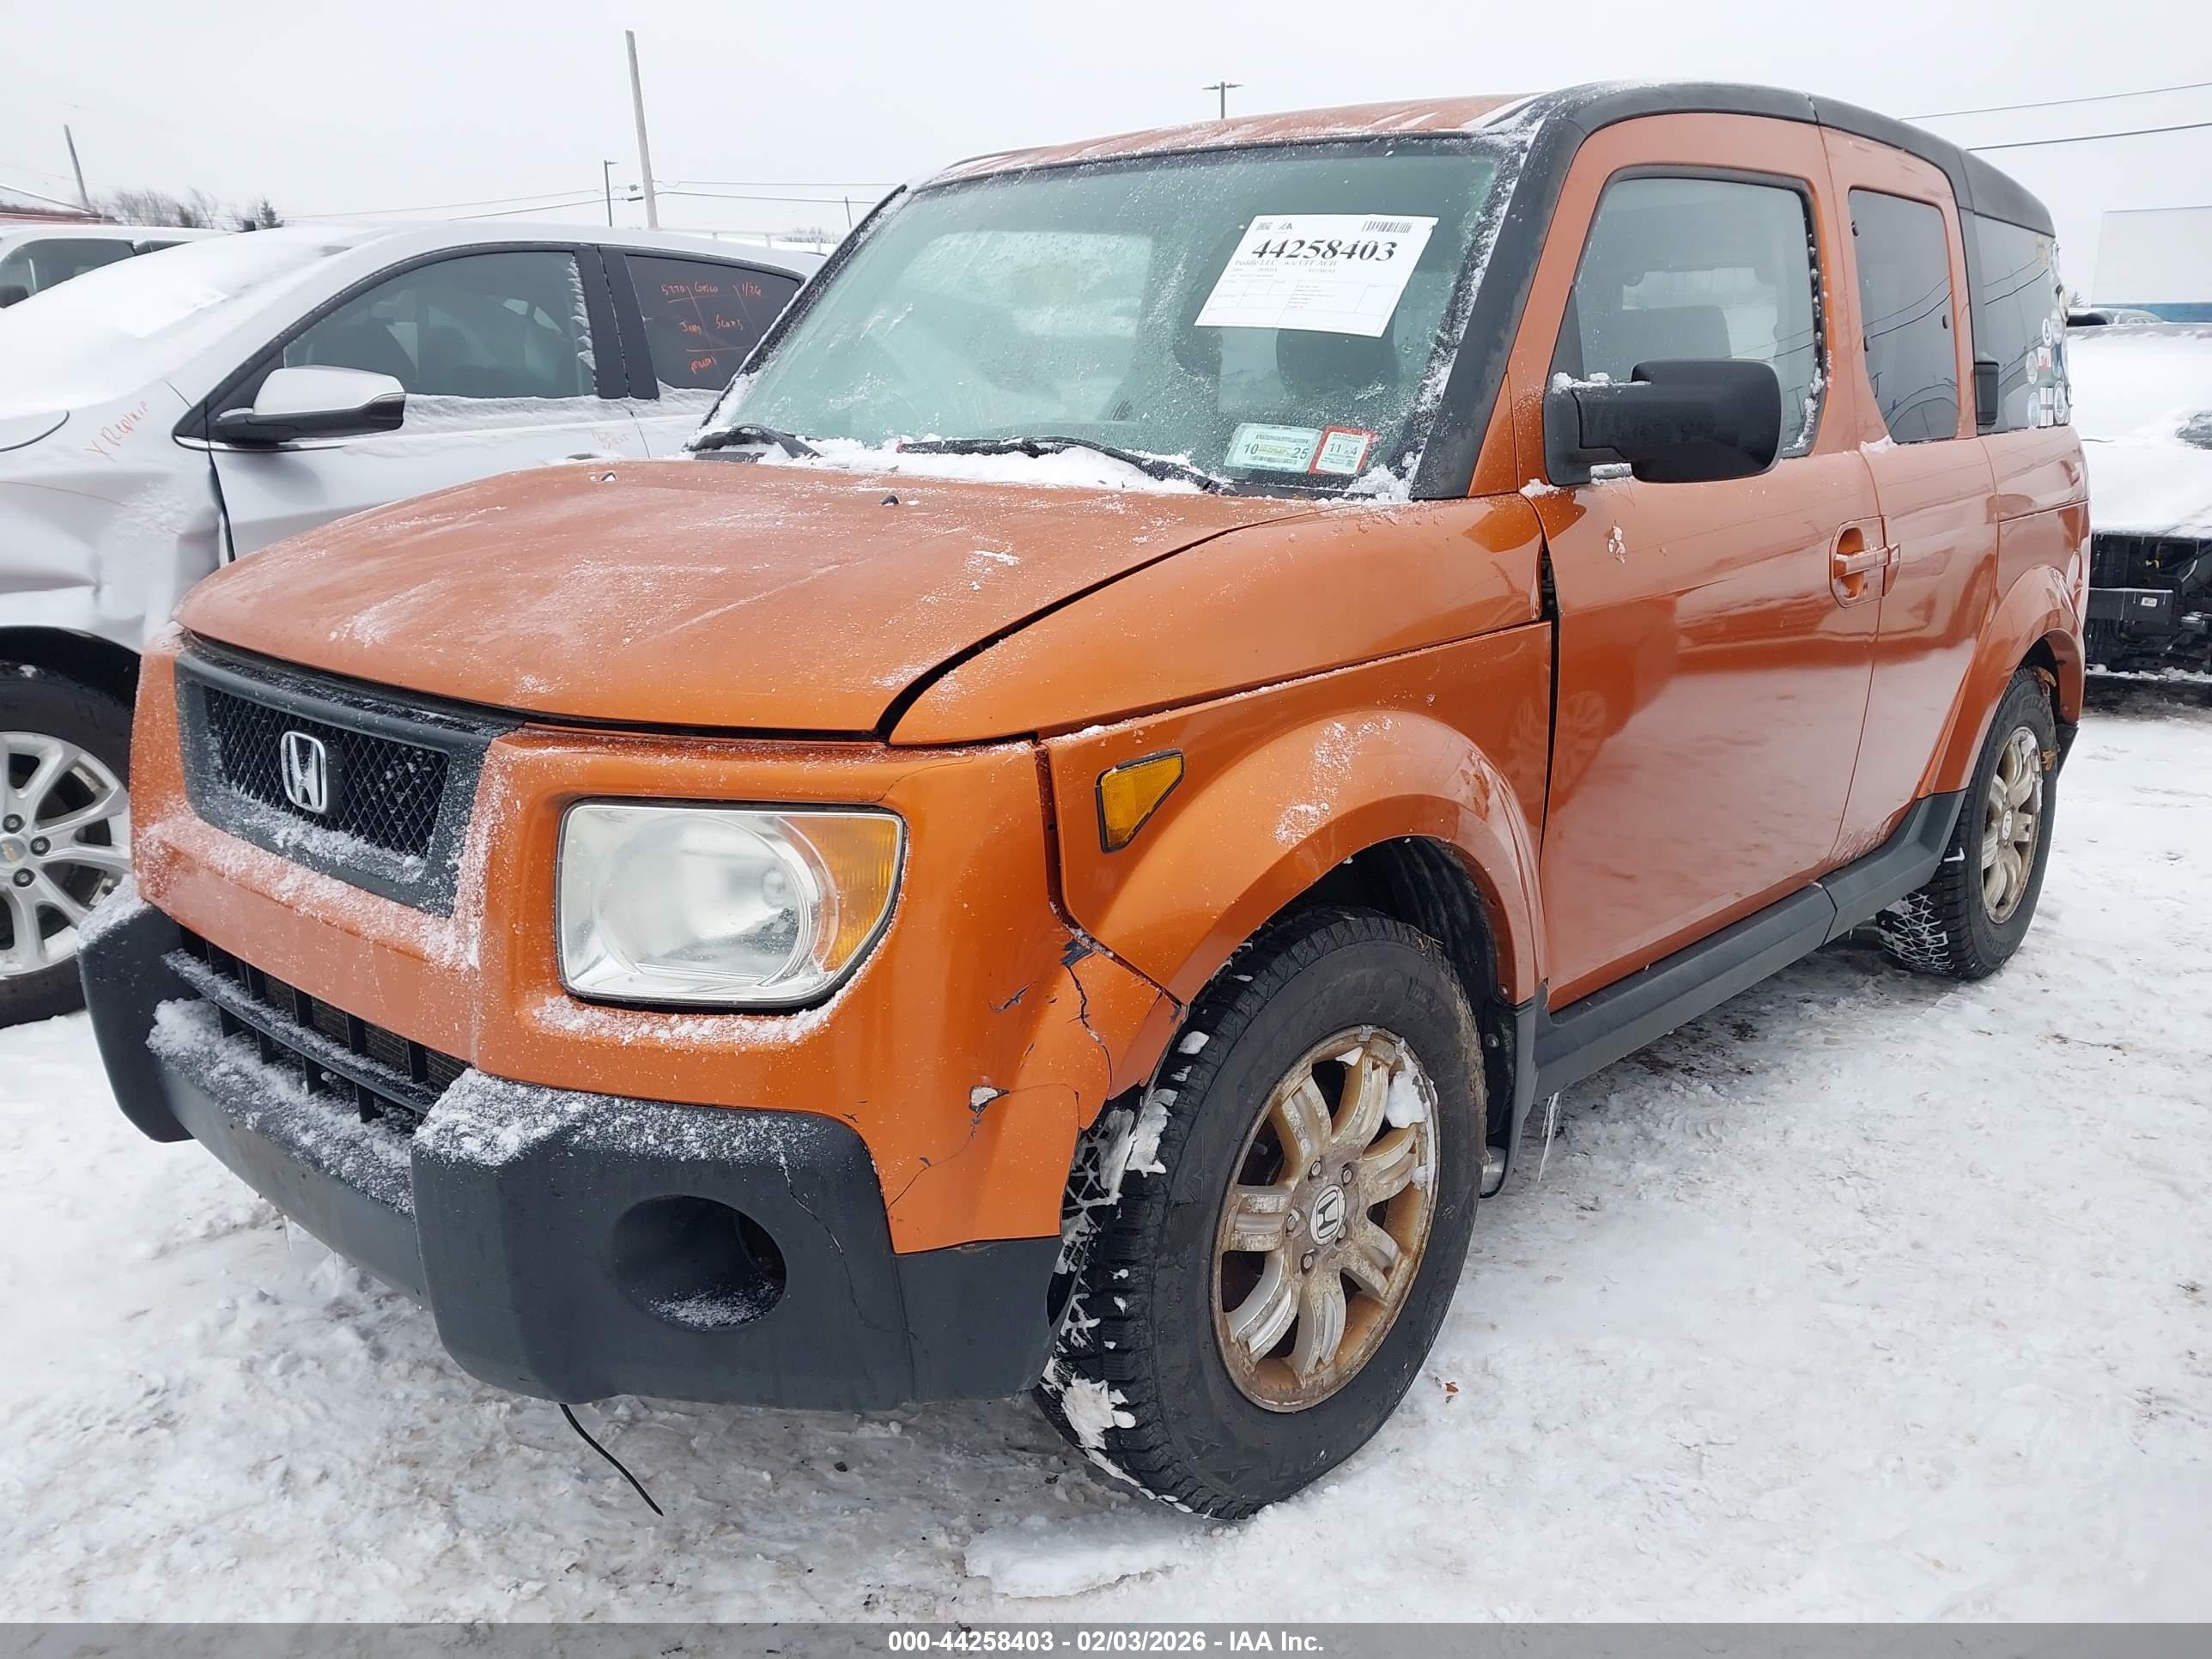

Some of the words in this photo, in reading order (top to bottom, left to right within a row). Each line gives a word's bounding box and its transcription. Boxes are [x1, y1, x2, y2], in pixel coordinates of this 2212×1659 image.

[1252, 239, 1398, 262] 44258403
[1244, 443, 1260, 455] 10
[1291, 447, 1310, 459] 25
[1329, 442, 1342, 453] 11
